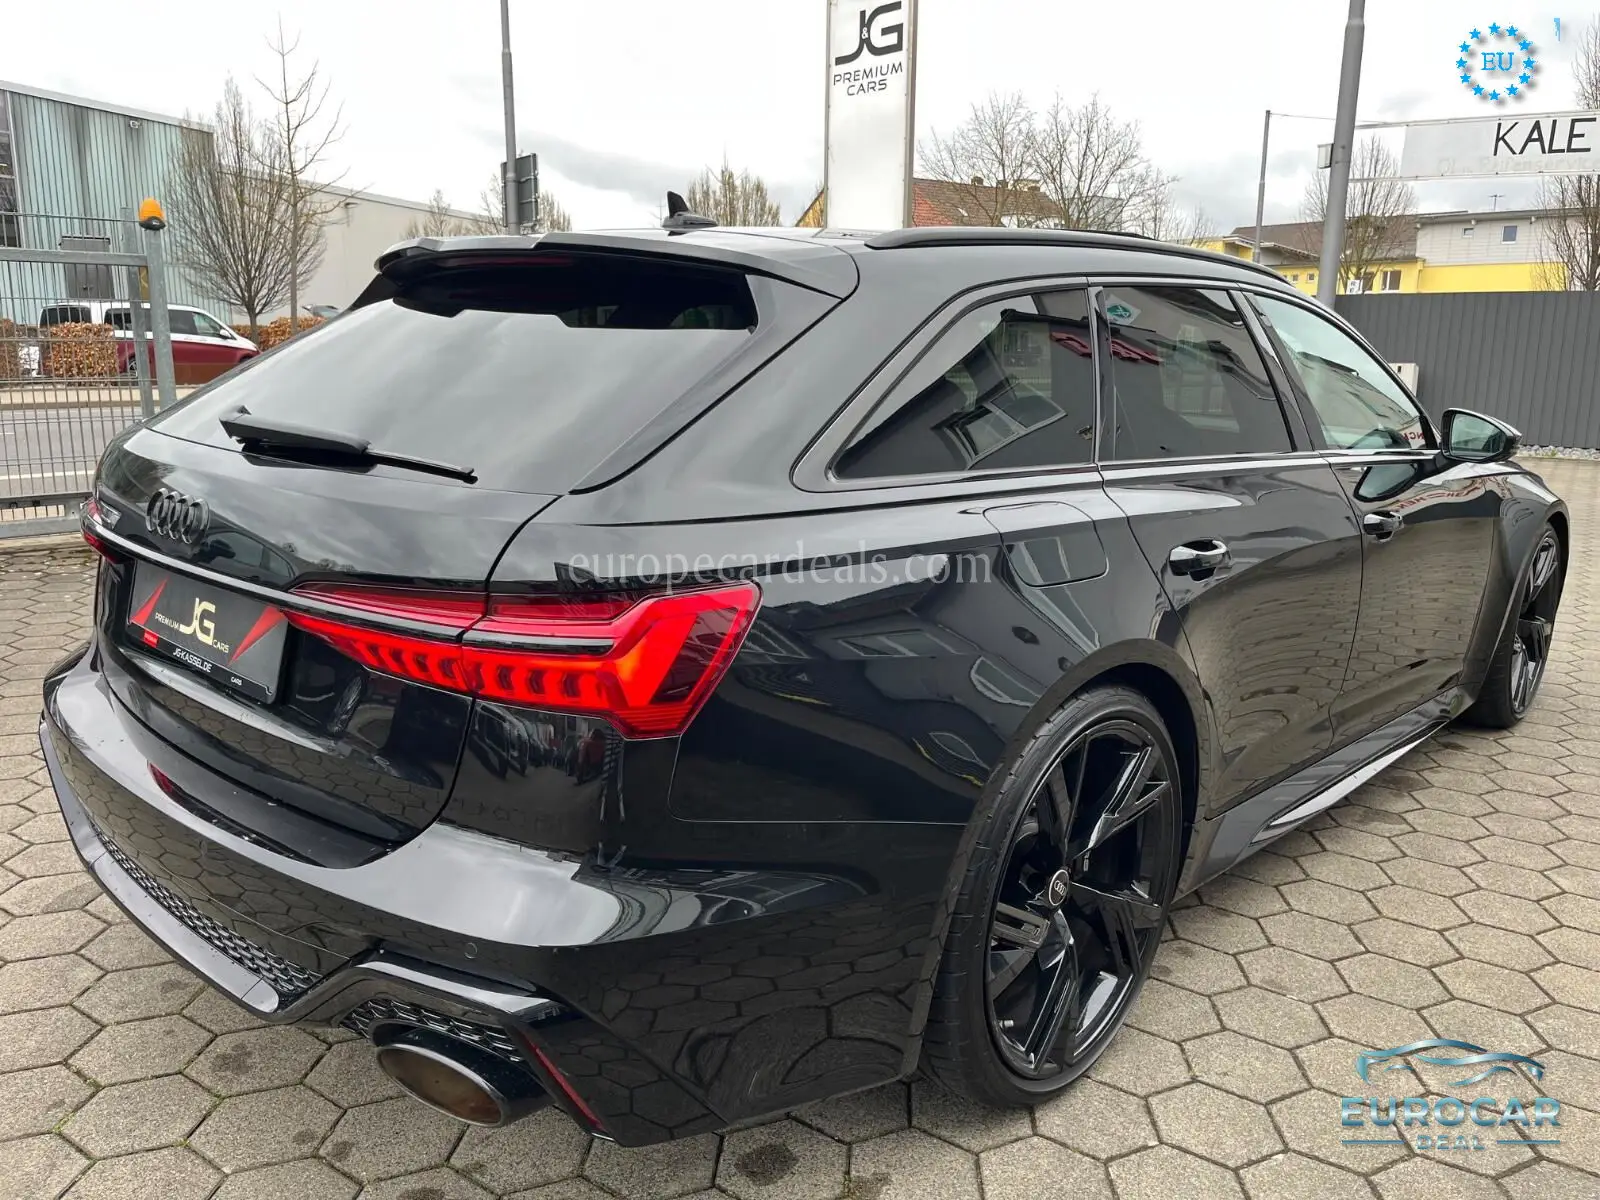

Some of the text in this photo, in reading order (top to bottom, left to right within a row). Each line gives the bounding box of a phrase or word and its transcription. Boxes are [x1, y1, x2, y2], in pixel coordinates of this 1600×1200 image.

[833, 61, 903, 86] PREMIUM
[846, 79, 887, 96] CARS
[1493, 117, 1597, 156] KALE
[154, 612, 180, 631] PREMIUM
[211, 638, 230, 654] CARS
